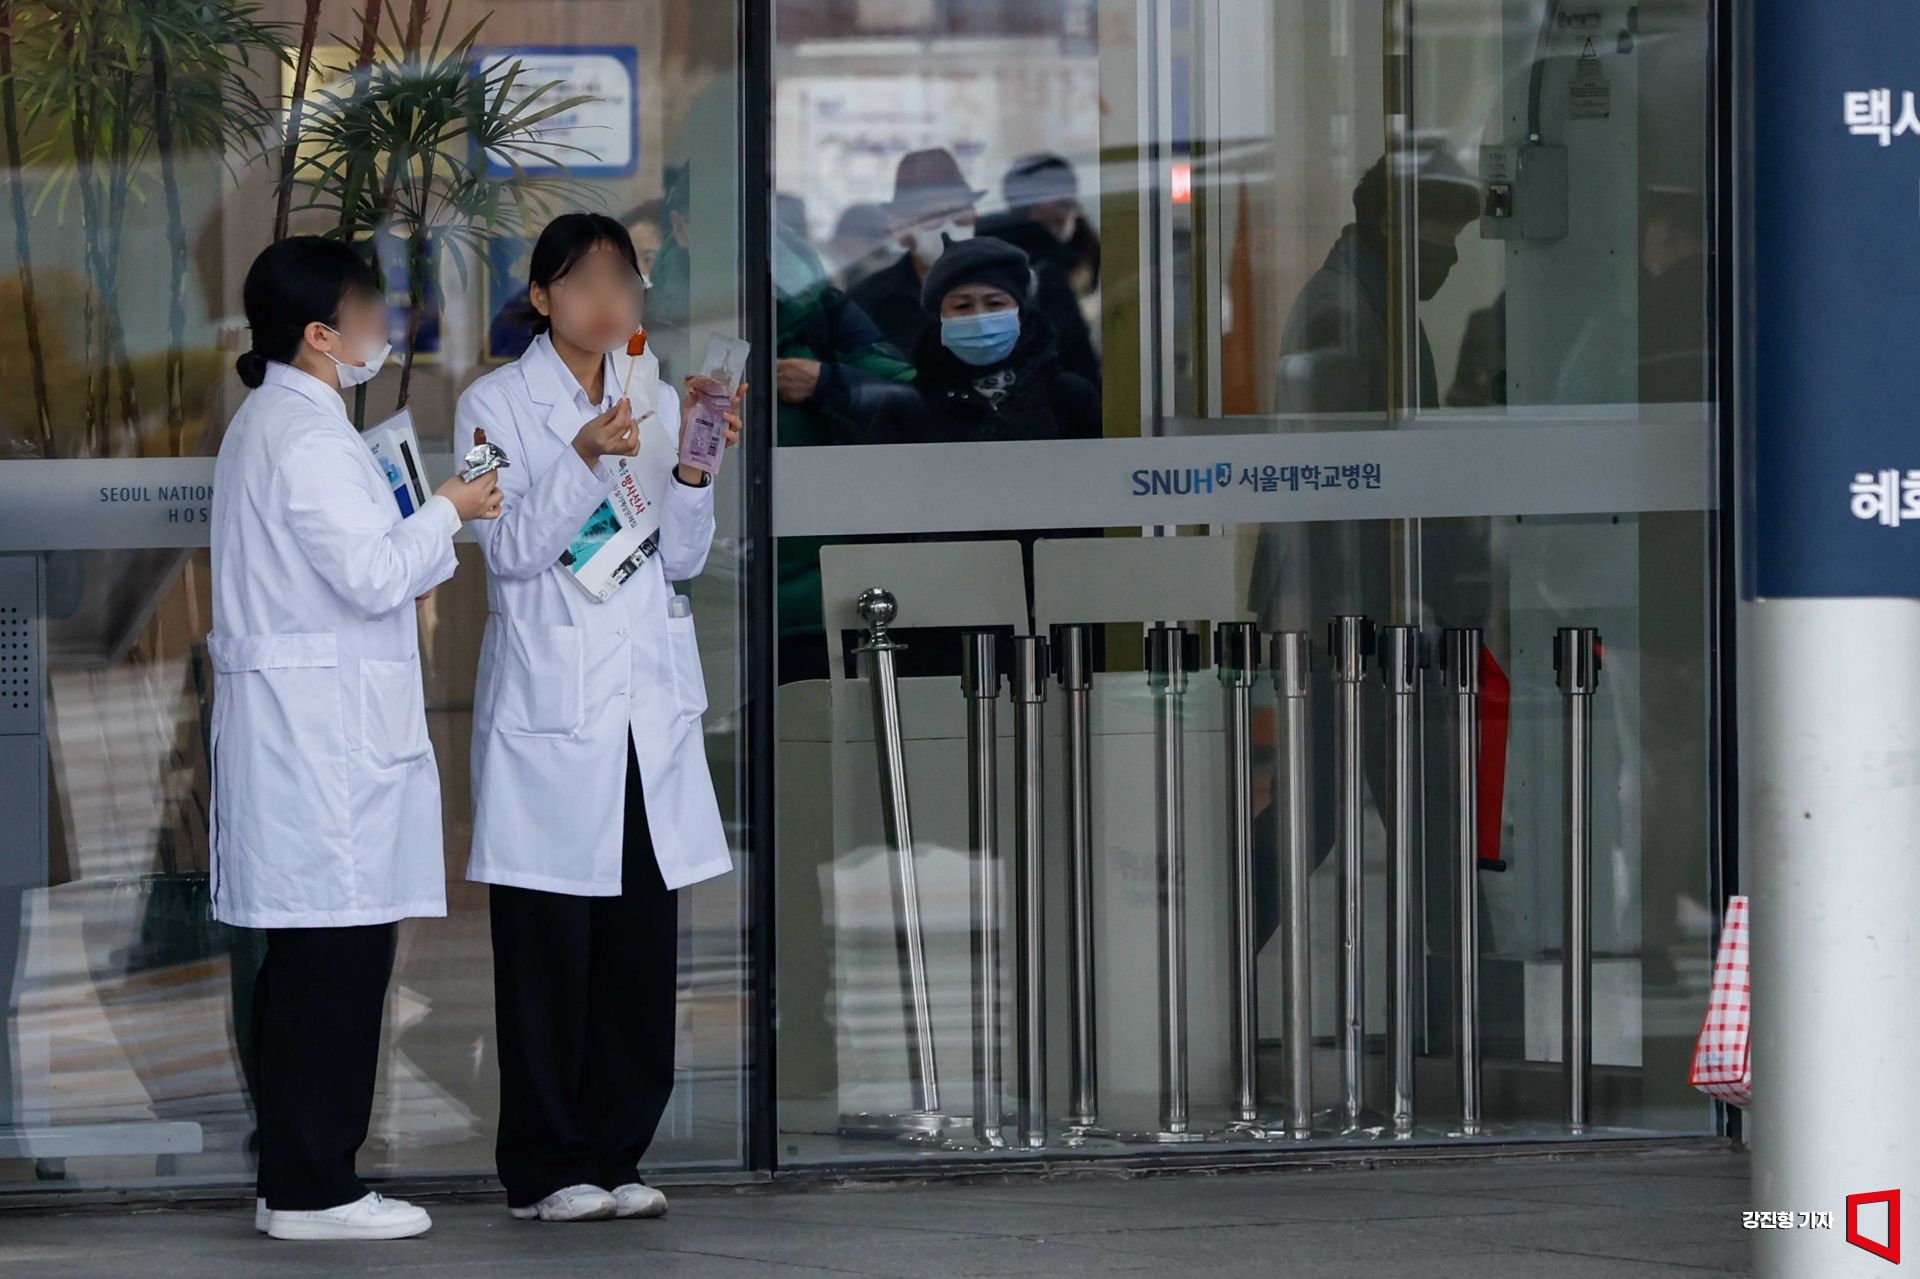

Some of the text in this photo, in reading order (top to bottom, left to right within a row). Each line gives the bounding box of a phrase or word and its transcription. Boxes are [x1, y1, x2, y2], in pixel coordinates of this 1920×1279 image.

[1132, 463, 1382, 496] SNUH 서울대학교병원
[100, 487, 151, 502] SEOUL
[621, 474, 646, 515] 방사선사
[168, 507, 208, 523] HOS
